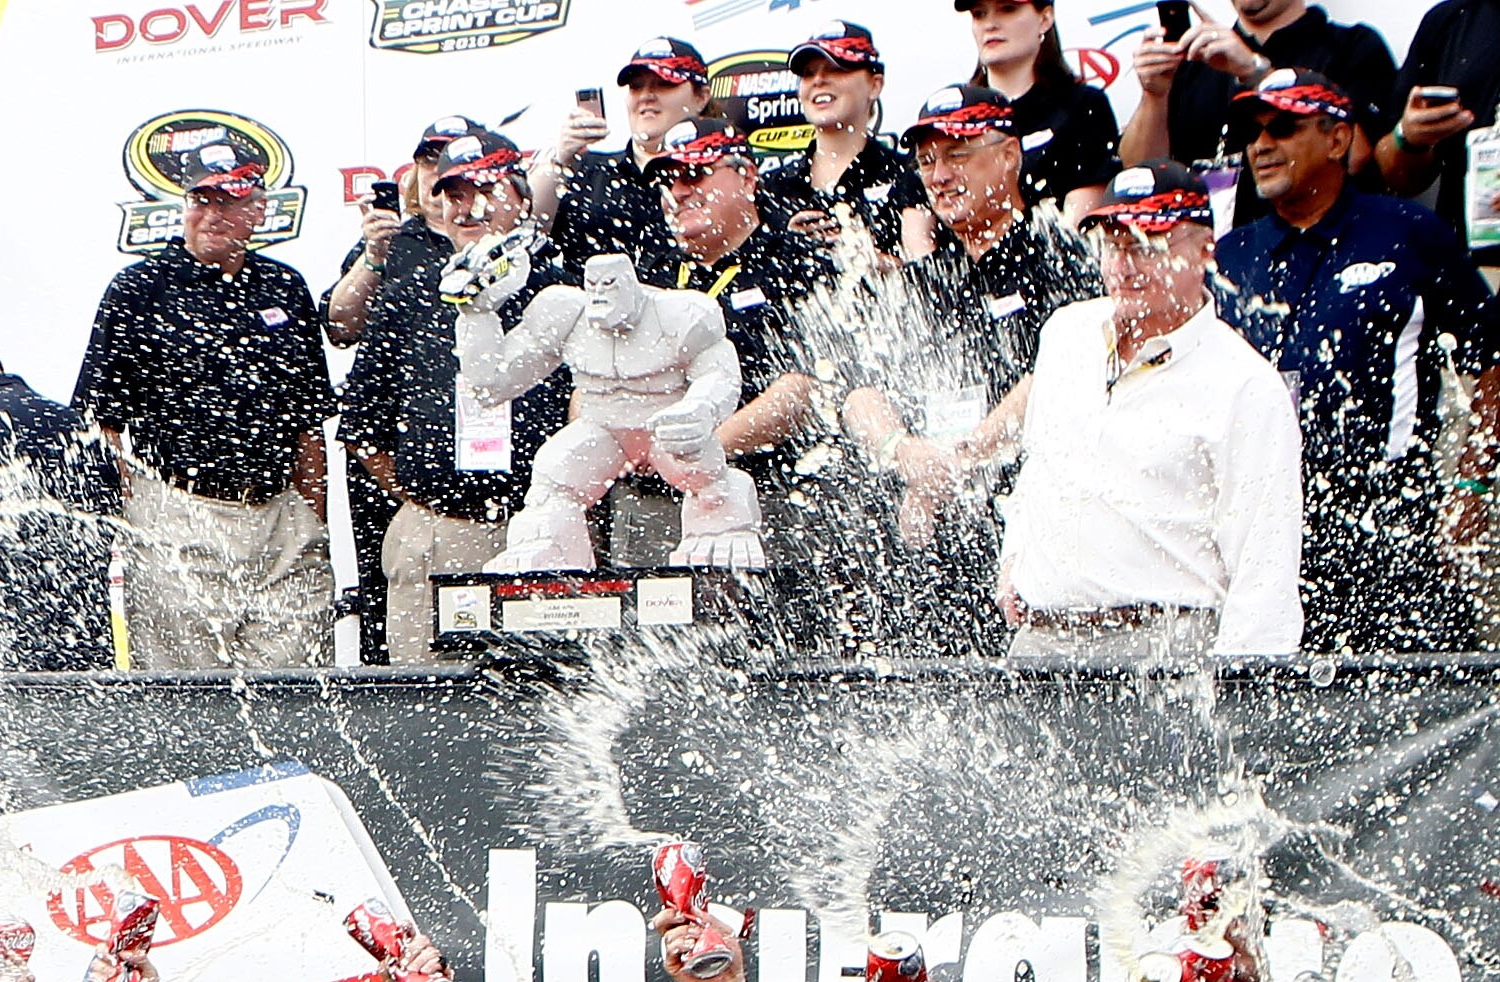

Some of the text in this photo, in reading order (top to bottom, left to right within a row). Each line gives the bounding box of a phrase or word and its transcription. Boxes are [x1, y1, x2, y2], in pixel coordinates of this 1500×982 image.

[90, 0, 329, 50] DOVER
[384, 3, 559, 38] SPRINT CUP
[116, 35, 303, 65] INTERNATIONAL SPEEDWAY
[440, 34, 490, 52] 2010
[738, 70, 798, 96] NASCAR
[747, 94, 804, 124] Sprin
[756, 131, 789, 143] CUP
